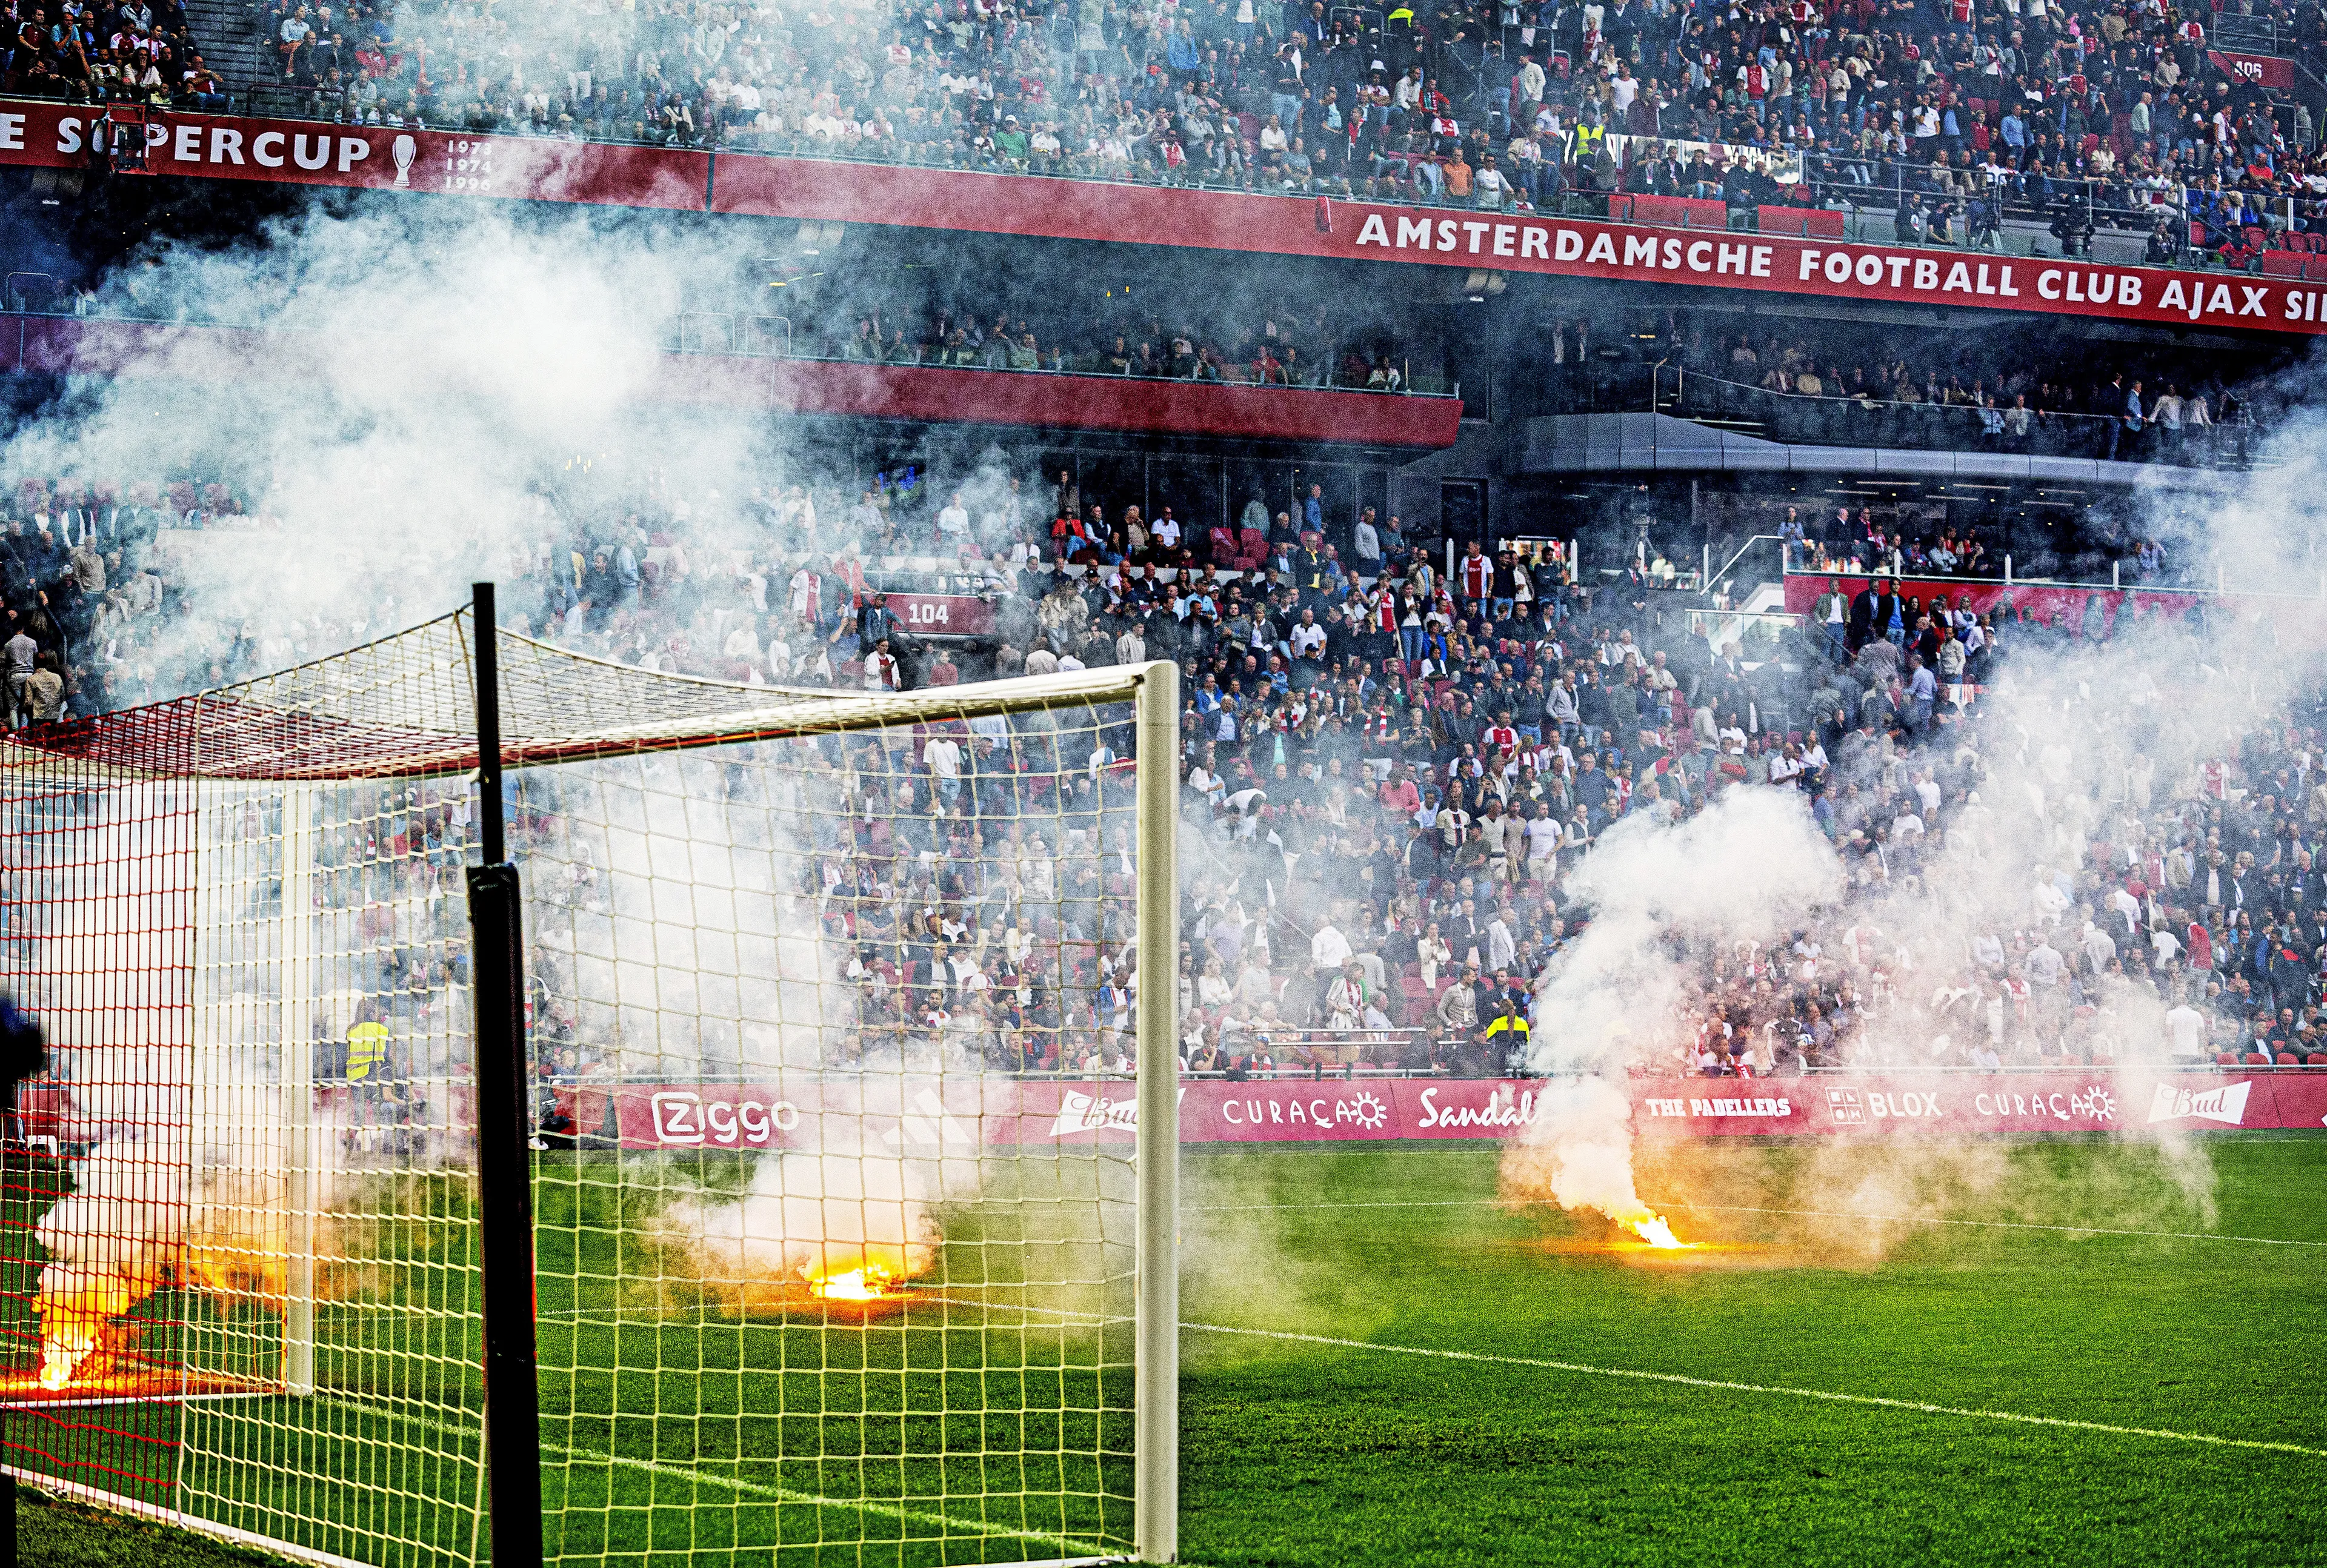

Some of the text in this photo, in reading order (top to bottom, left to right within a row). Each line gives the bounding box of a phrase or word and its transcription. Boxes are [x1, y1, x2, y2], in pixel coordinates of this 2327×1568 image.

[0, 113, 25, 150] E
[448, 140, 492, 155] 1973
[447, 158, 491, 173] 1974
[446, 176, 490, 191] 1996
[1356, 214, 1773, 277] AMSTERDAMSCHE
[1799, 250, 2019, 296] FOOTBALL
[2037, 269, 2142, 305] CLUB
[2158, 279, 2268, 320] AJAX
[909, 603, 949, 624] 104
[1071, 1097, 1137, 1128] Bu
[1645, 1098, 1791, 1117] THE PADELLERS
[1867, 1092, 1943, 1117] BLOX
[2161, 1089, 2228, 1115] Bud
